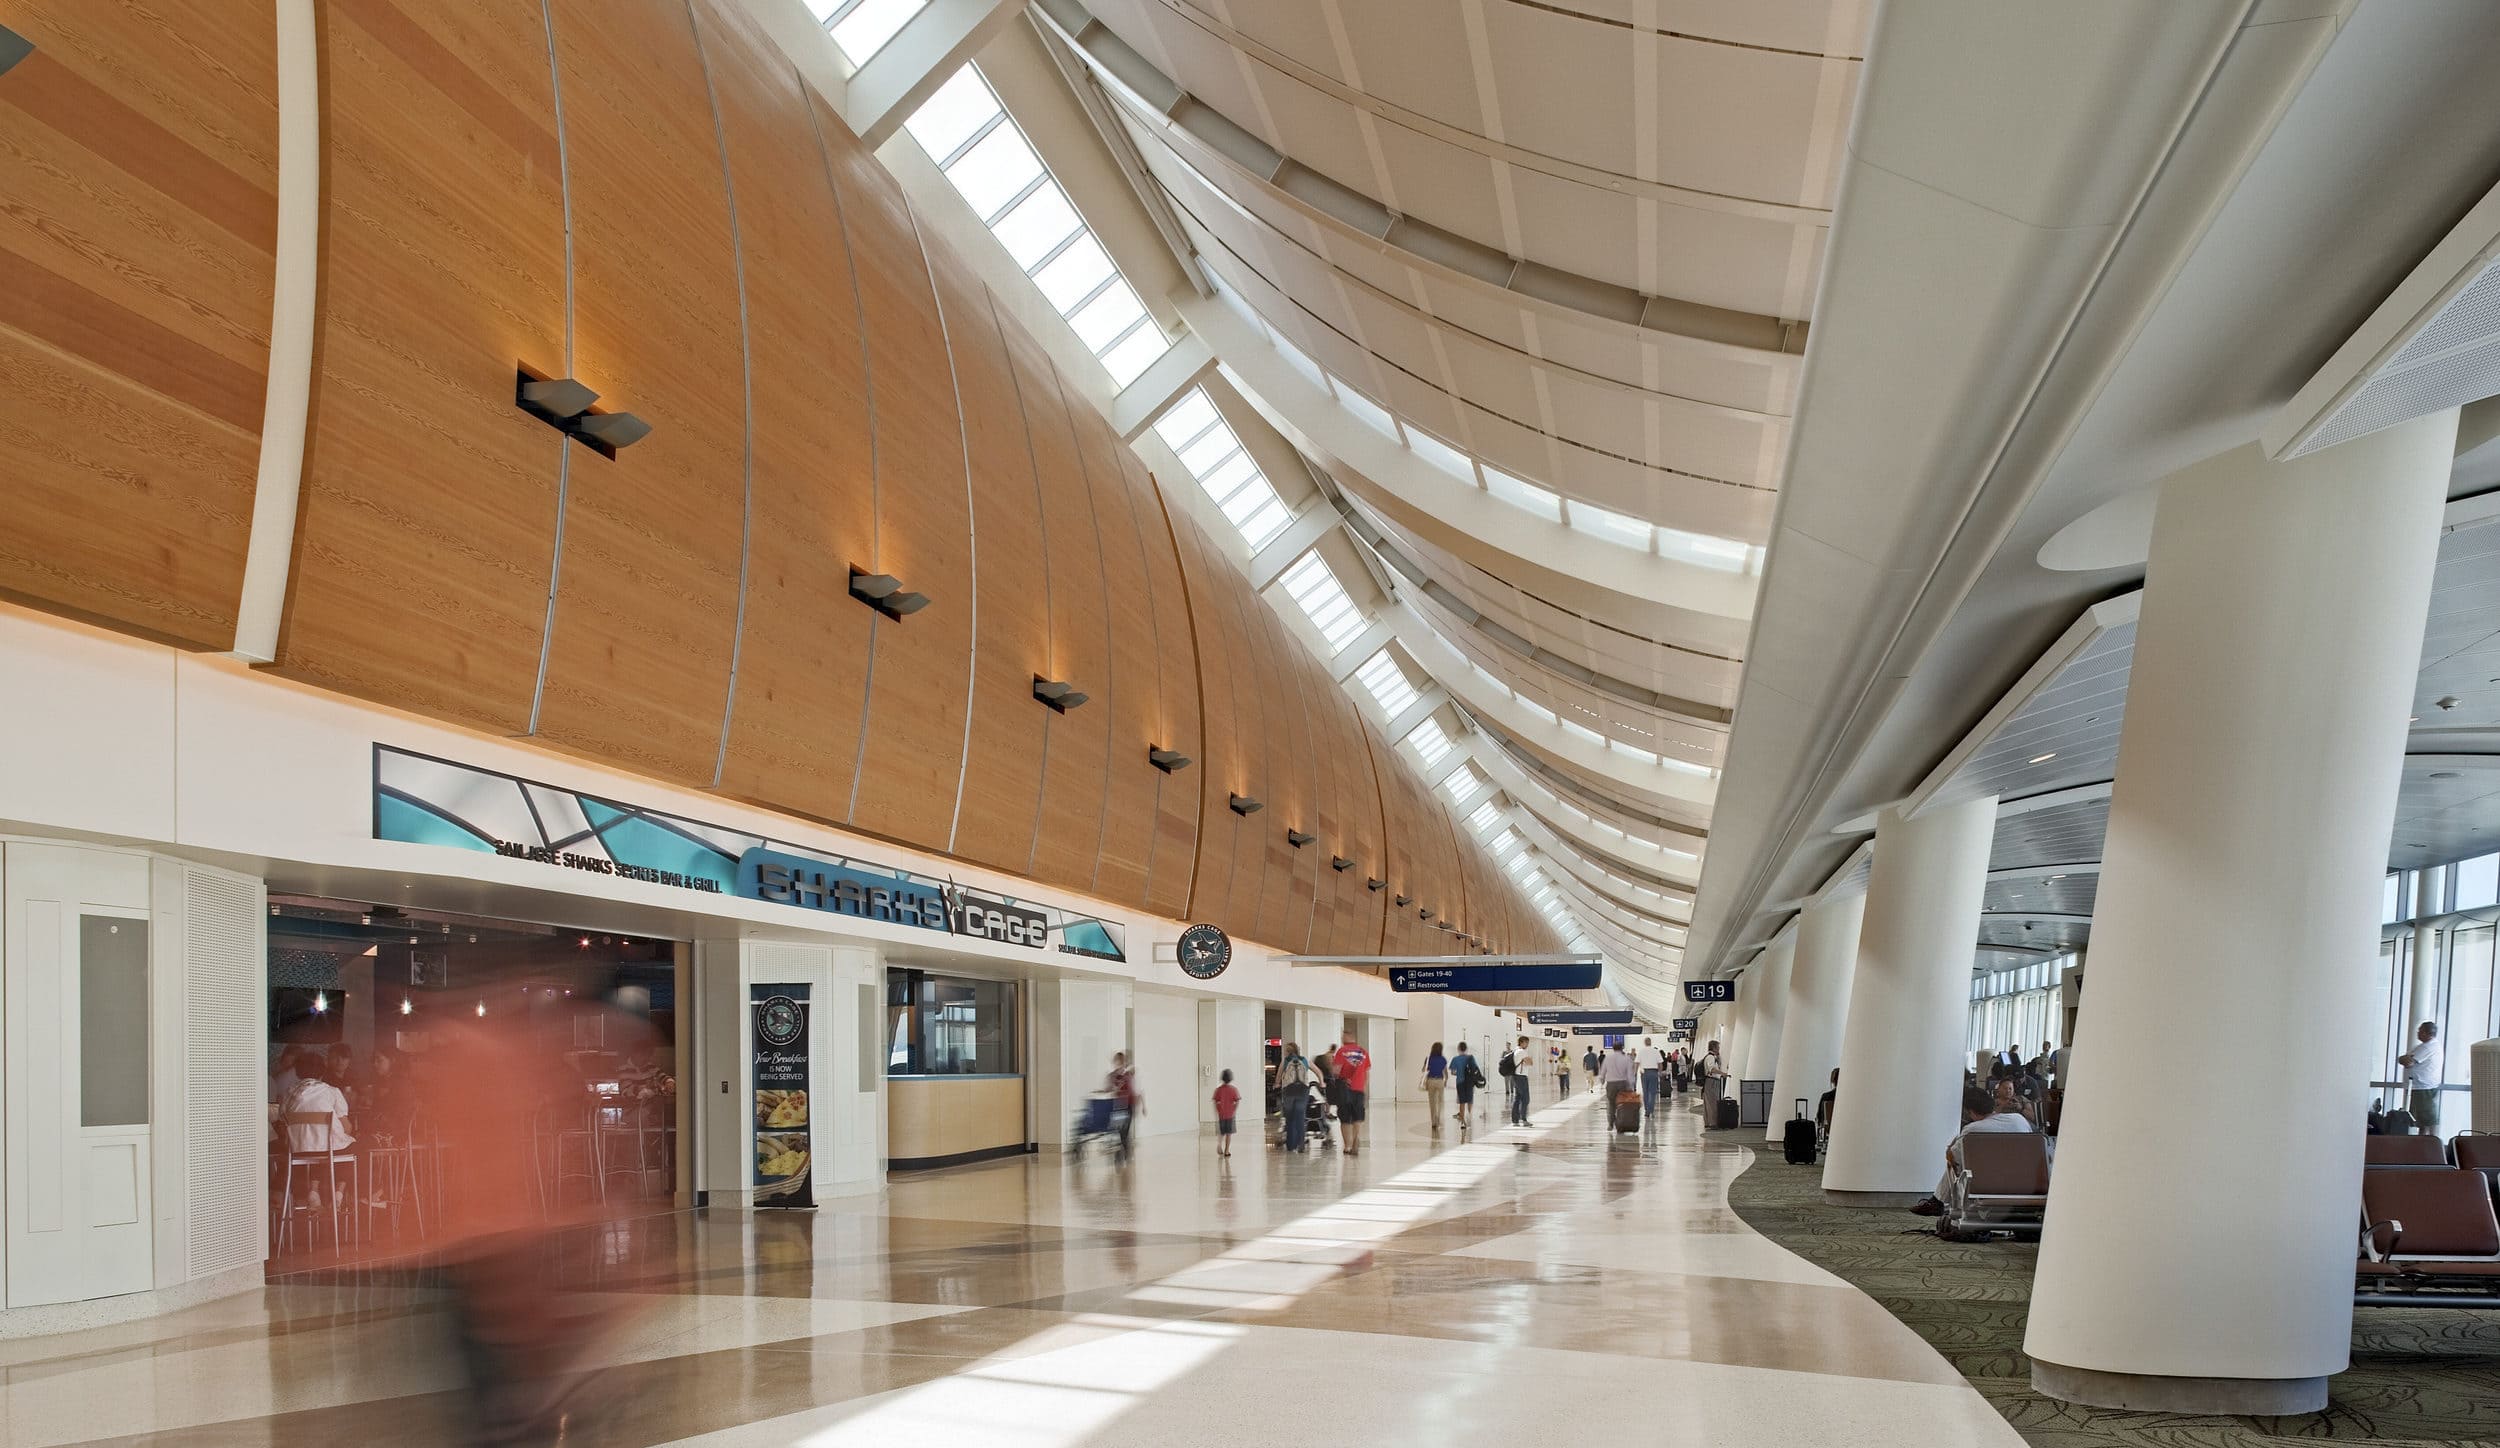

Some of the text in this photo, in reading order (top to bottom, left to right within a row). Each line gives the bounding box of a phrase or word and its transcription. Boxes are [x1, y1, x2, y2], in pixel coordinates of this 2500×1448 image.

[496, 840, 524, 858] SAN
[525, 846, 561, 866] JOSE
[563, 852, 613, 875] SHARKS
[660, 870, 683, 887] BAR
[684, 875, 693, 889] &
[694, 876, 723, 893] GRILL
[757, 863, 1047, 948] SHARKS CAGE
[1708, 985, 1725, 998] 19
[1684, 1020, 1694, 1028] 20
[755, 1051, 807, 1064] Your Breakfast
